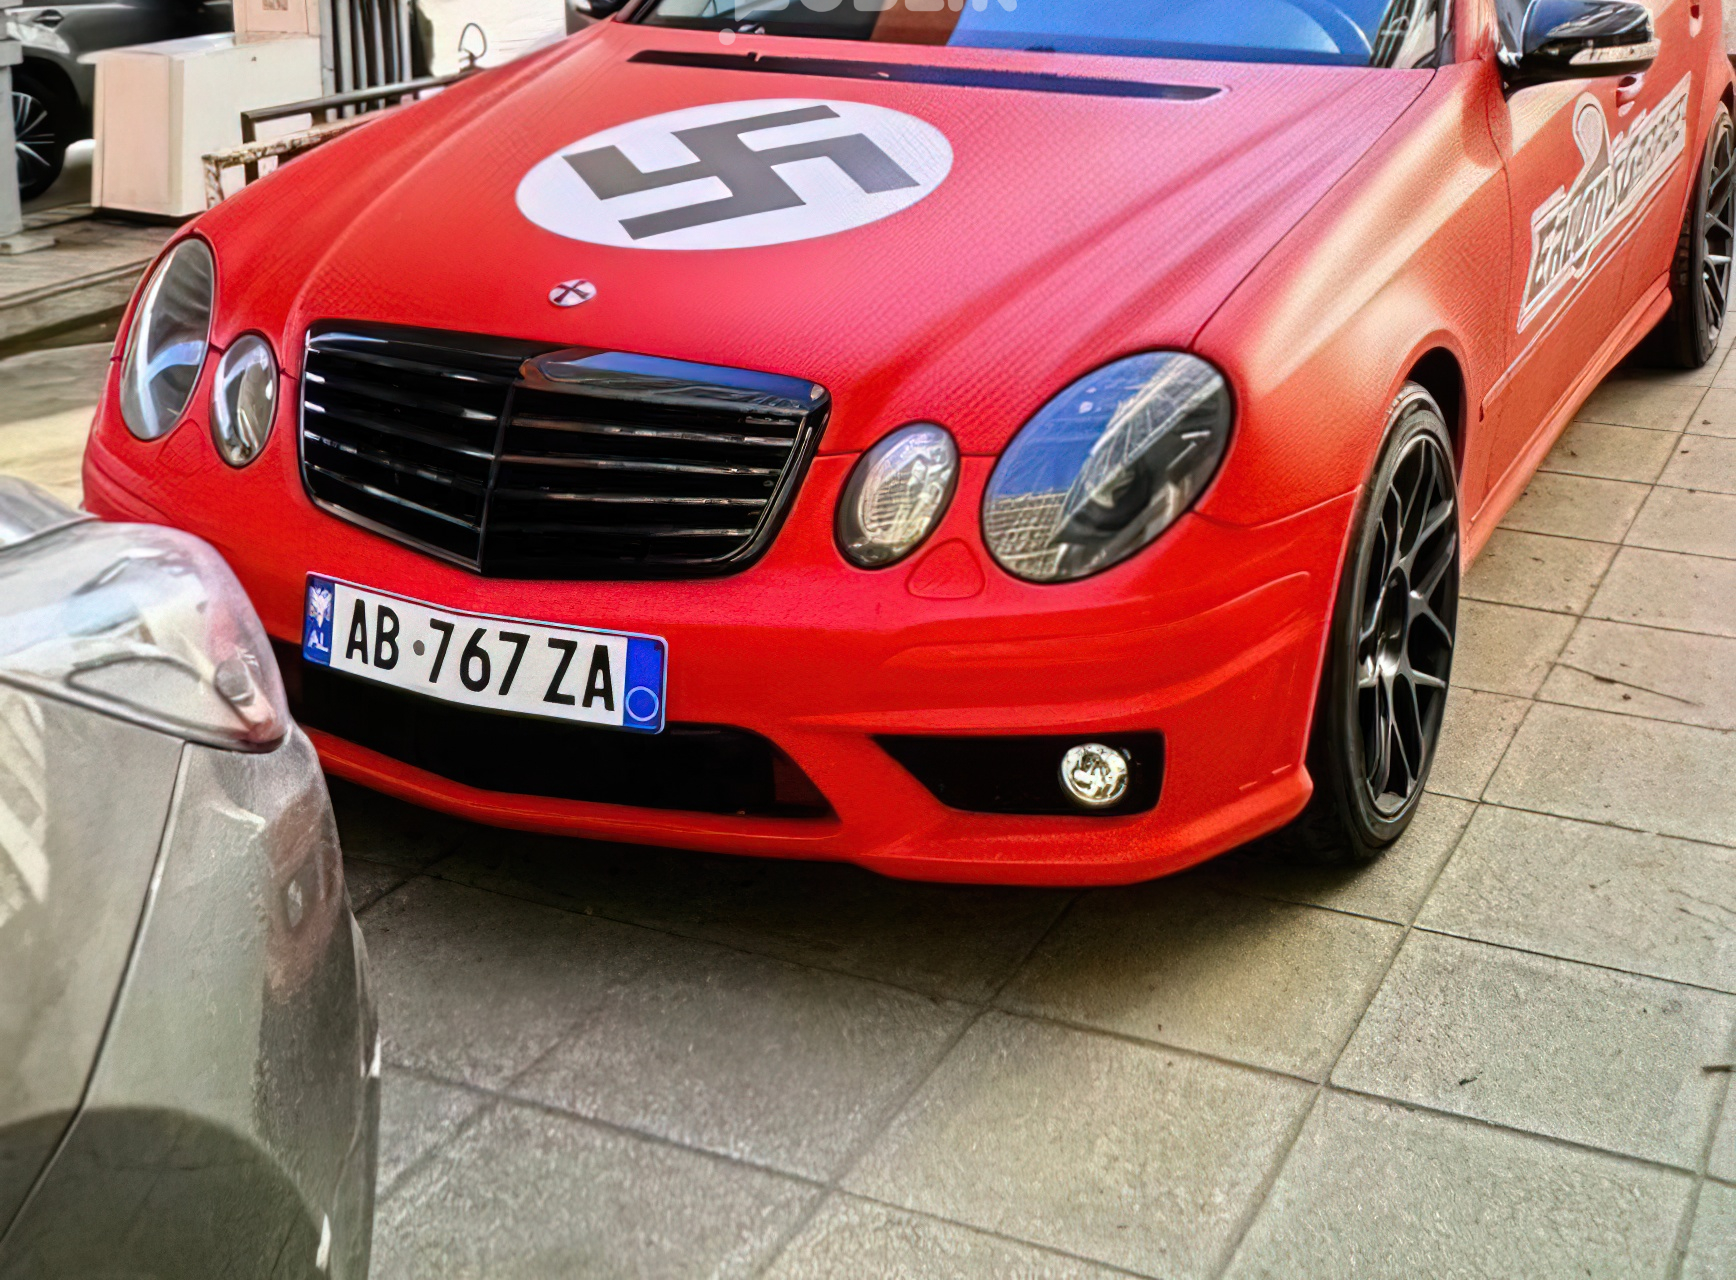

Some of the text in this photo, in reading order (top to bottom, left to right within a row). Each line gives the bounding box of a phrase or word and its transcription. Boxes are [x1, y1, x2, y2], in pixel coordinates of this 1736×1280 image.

[345, 598, 616, 712] AB 767 ZA
